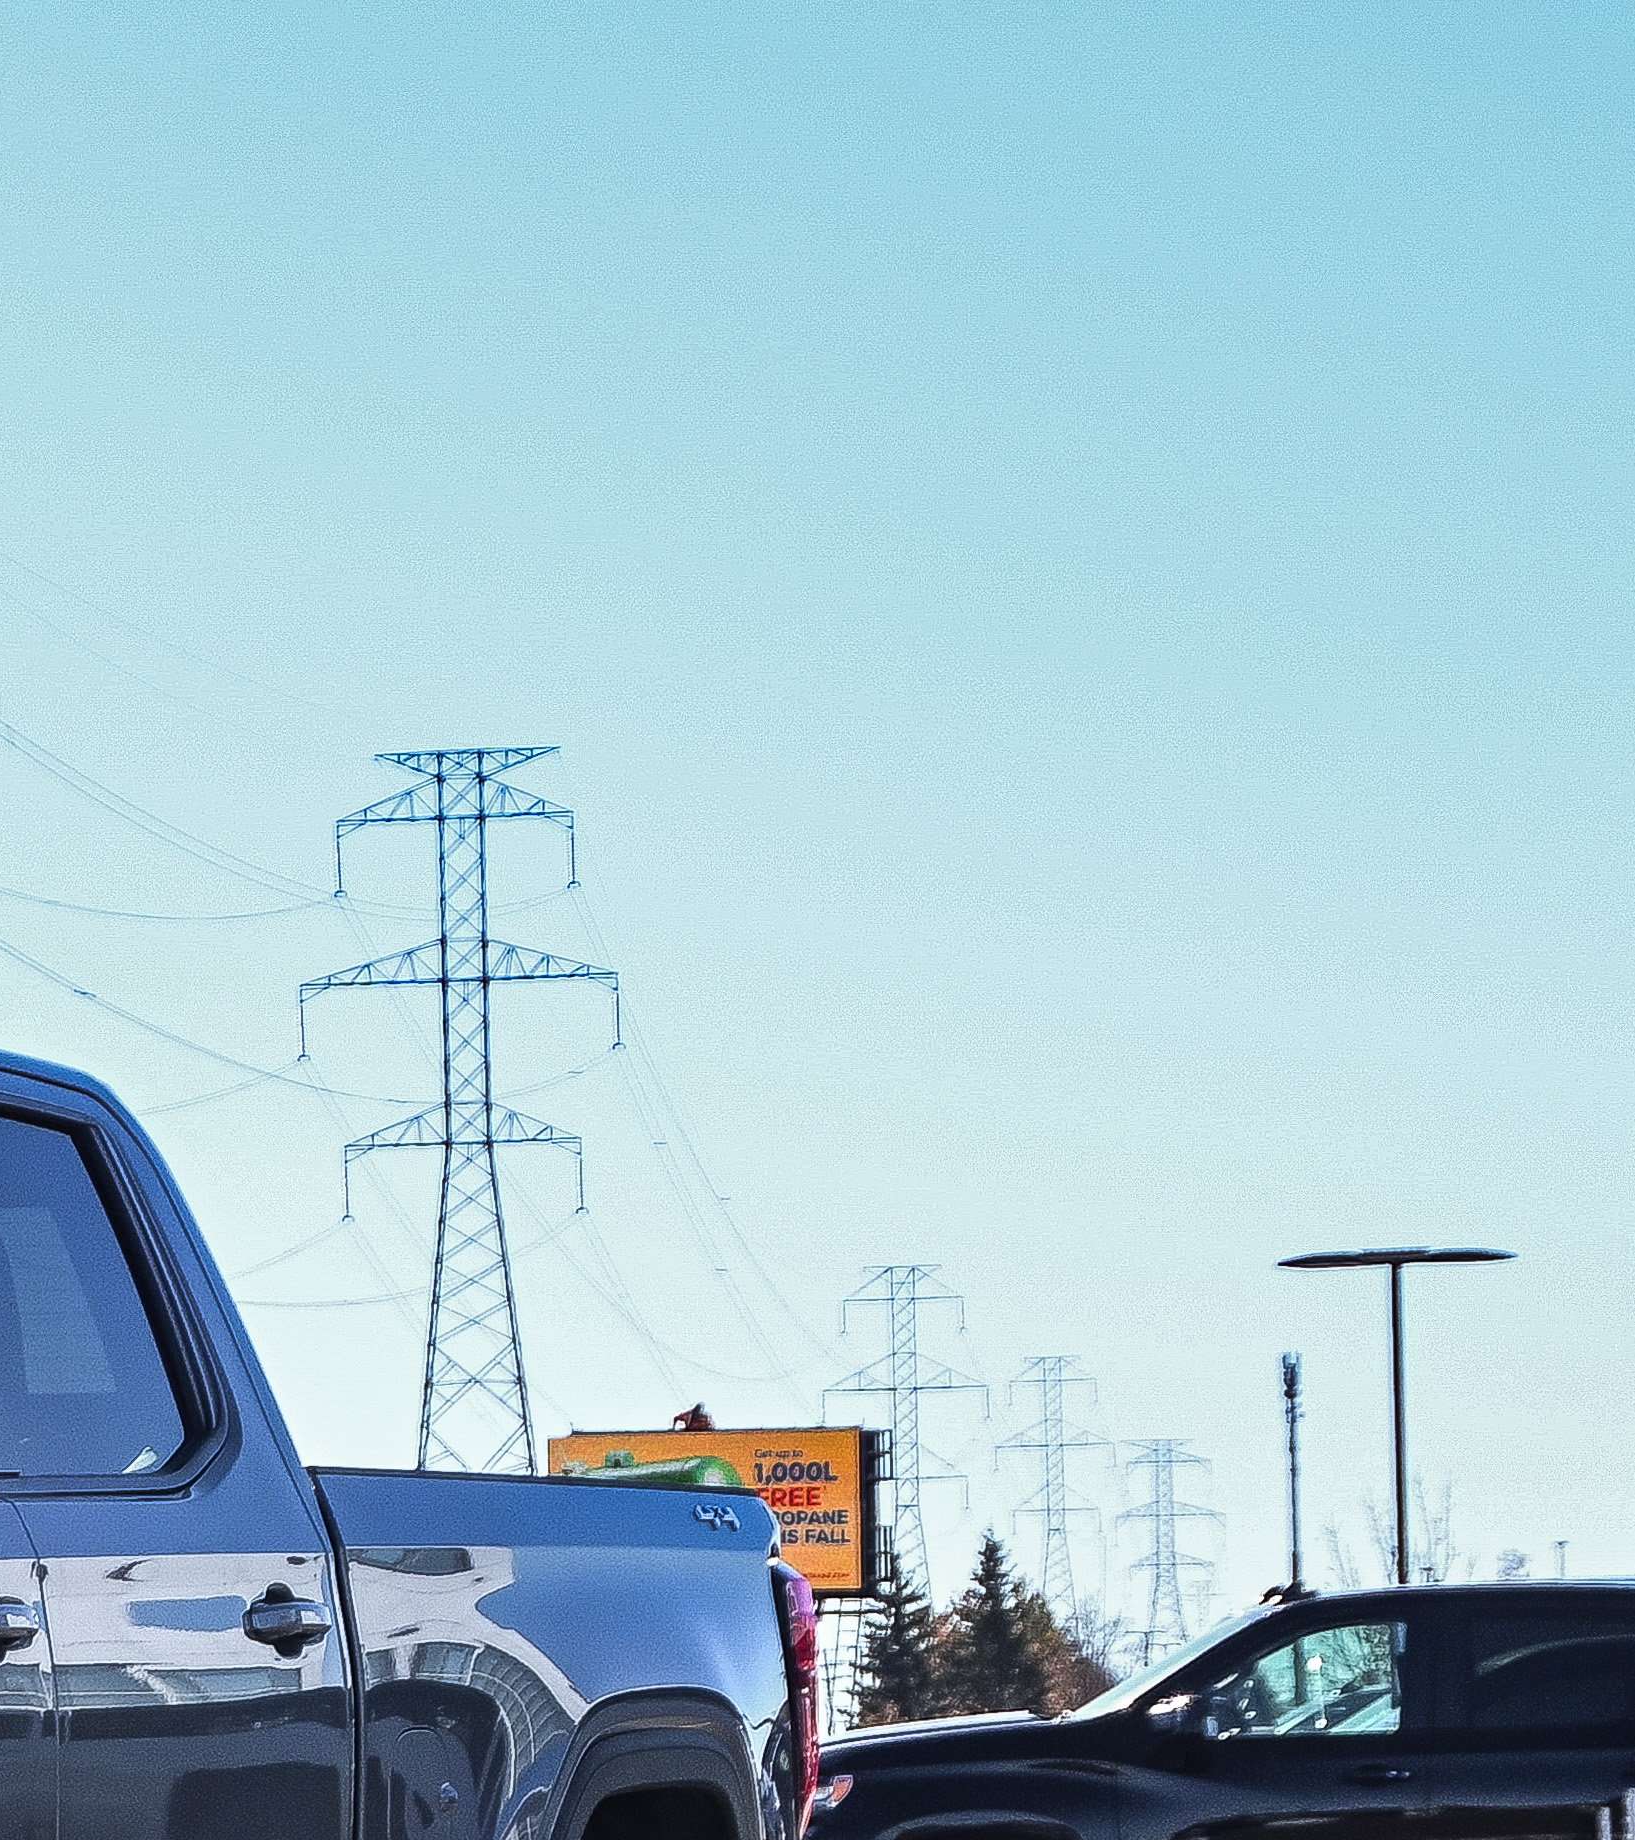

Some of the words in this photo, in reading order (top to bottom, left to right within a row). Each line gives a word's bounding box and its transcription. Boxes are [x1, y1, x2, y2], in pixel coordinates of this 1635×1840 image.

[754, 1461, 838, 1484] 1,000L
[774, 1509, 848, 1525] OPANE
[781, 1529, 798, 1543] IS
[805, 1528, 850, 1543] FALL
